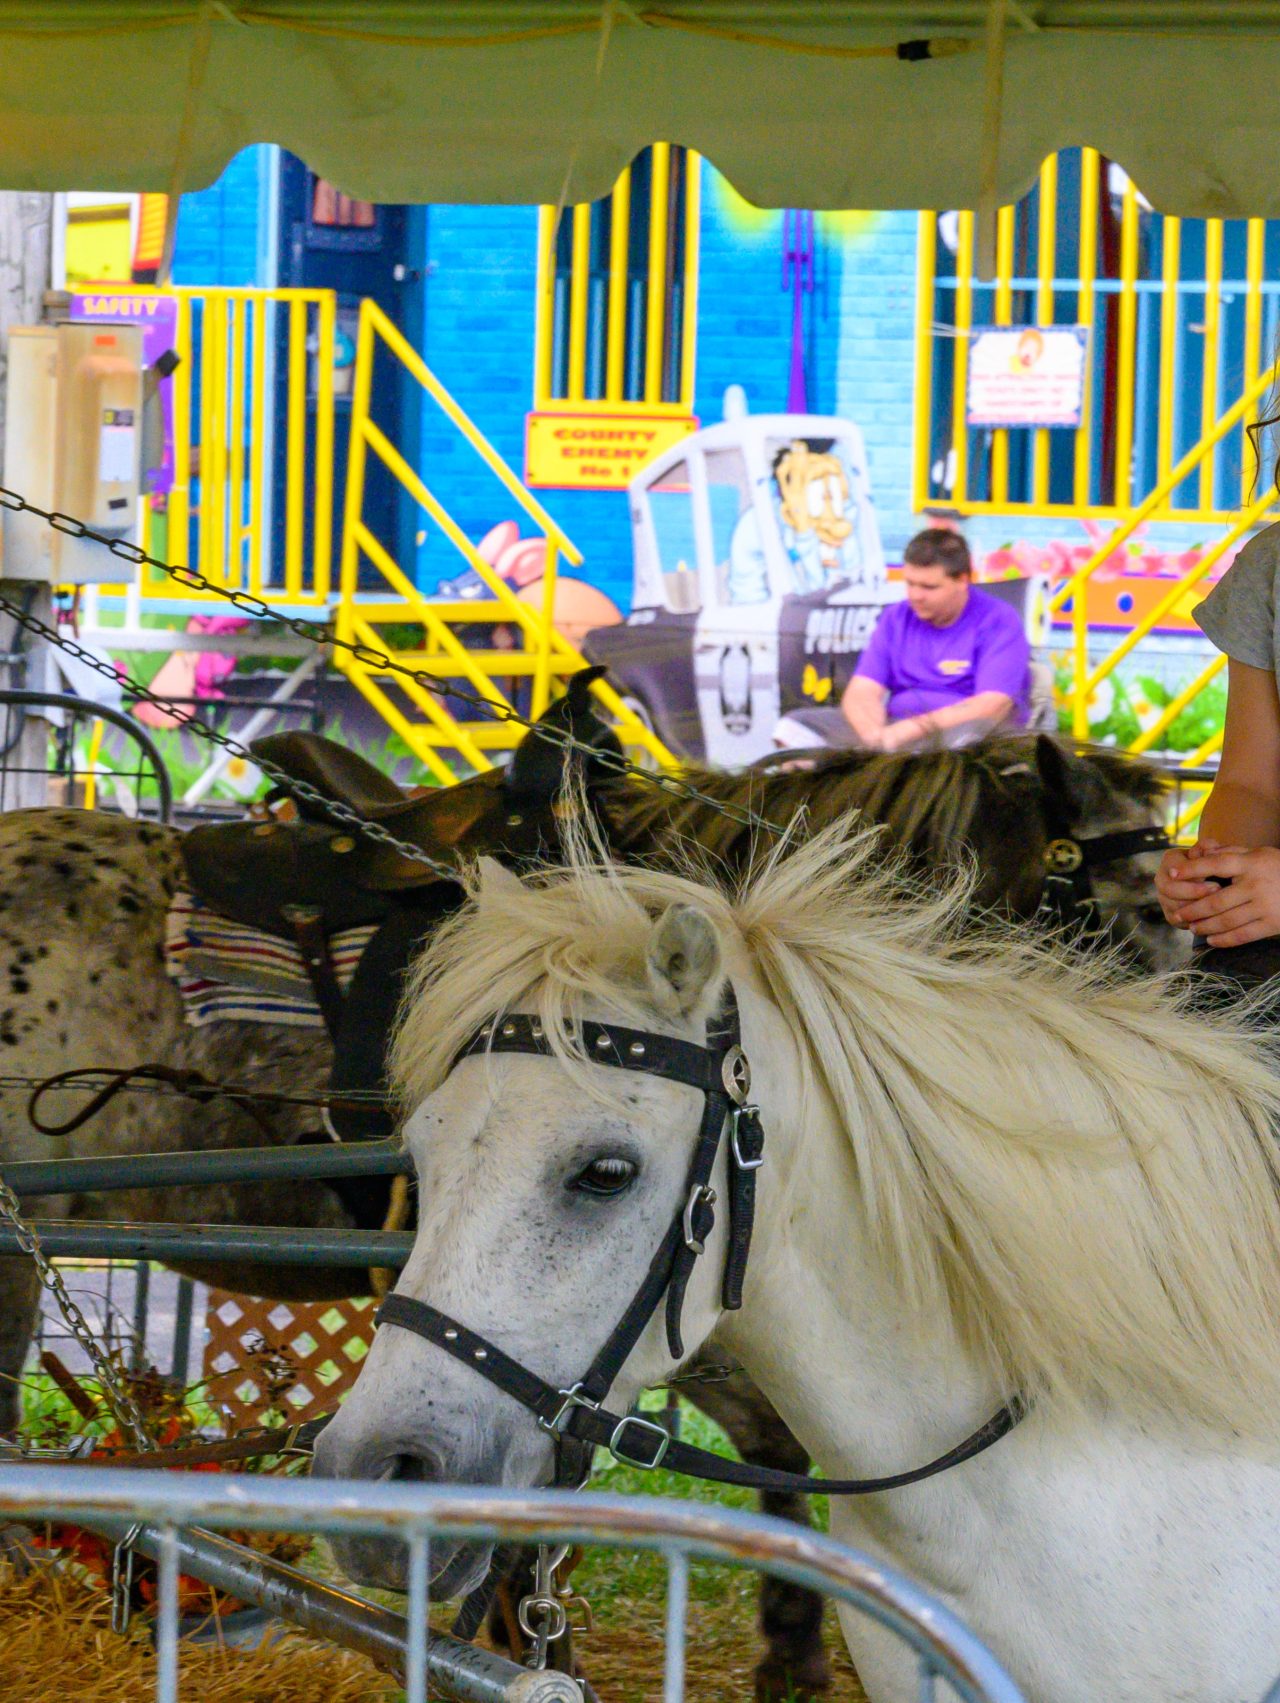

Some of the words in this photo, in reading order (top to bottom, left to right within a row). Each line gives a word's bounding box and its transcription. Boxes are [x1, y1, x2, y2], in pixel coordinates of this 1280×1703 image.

[83, 297, 158, 315] SAFETY
[553, 428, 656, 442] COUNTY
[561, 446, 648, 460] ENEMY
